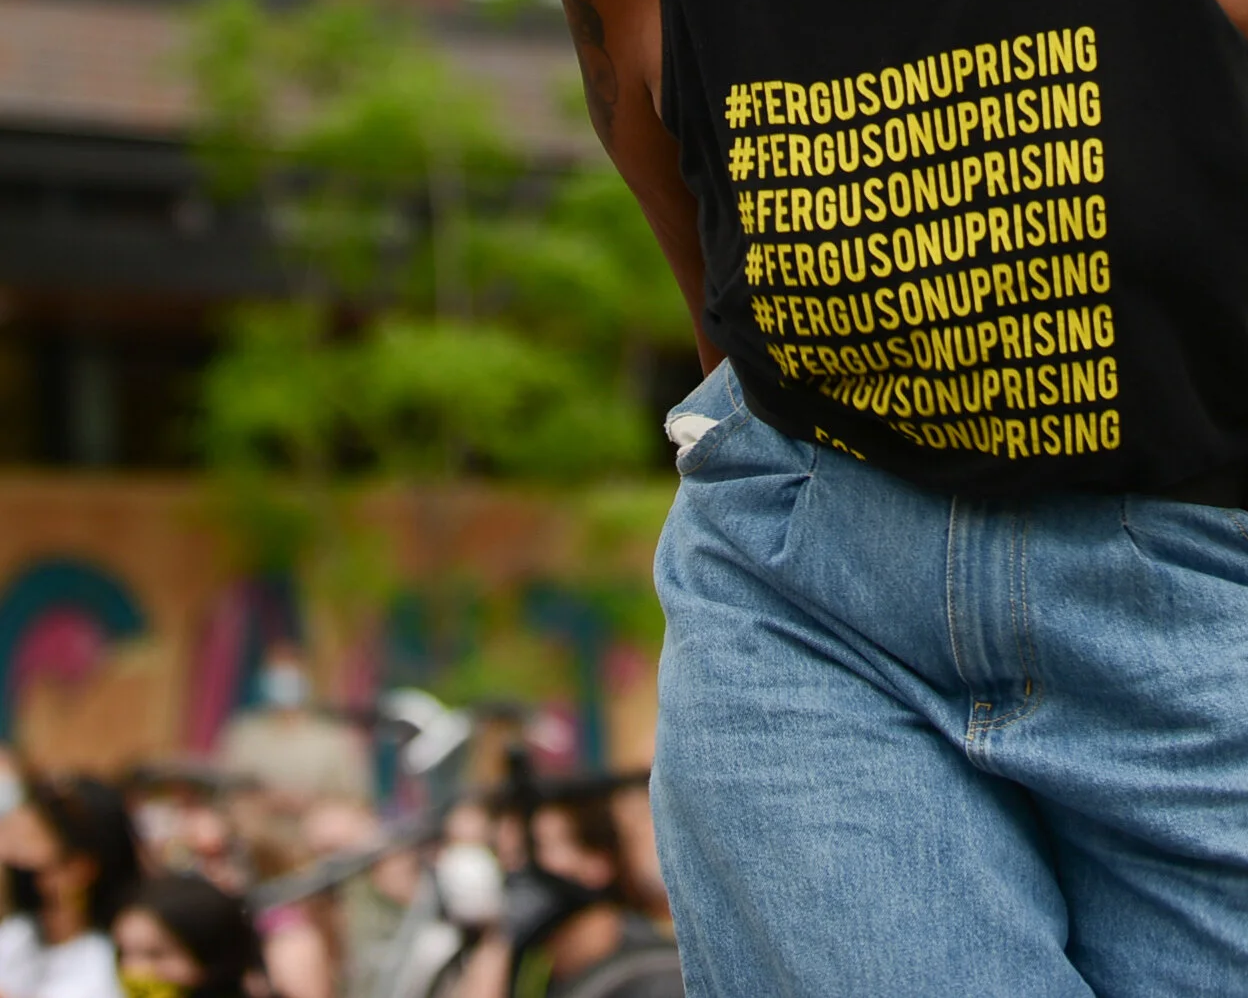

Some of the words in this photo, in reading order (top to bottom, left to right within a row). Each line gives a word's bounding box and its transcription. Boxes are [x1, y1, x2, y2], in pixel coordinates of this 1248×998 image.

[725, 26, 1098, 129] #FERGUSONUPRISING
[729, 81, 1102, 181] #FERGUSONUPRISING
[738, 138, 1105, 234] #FERGUSONUPRISING
[745, 194, 1108, 287] #FERGUSONUPRISING
[751, 250, 1112, 337] #FERGUSONUPRISING
[766, 304, 1115, 380] #FERGUSONUPRISING
